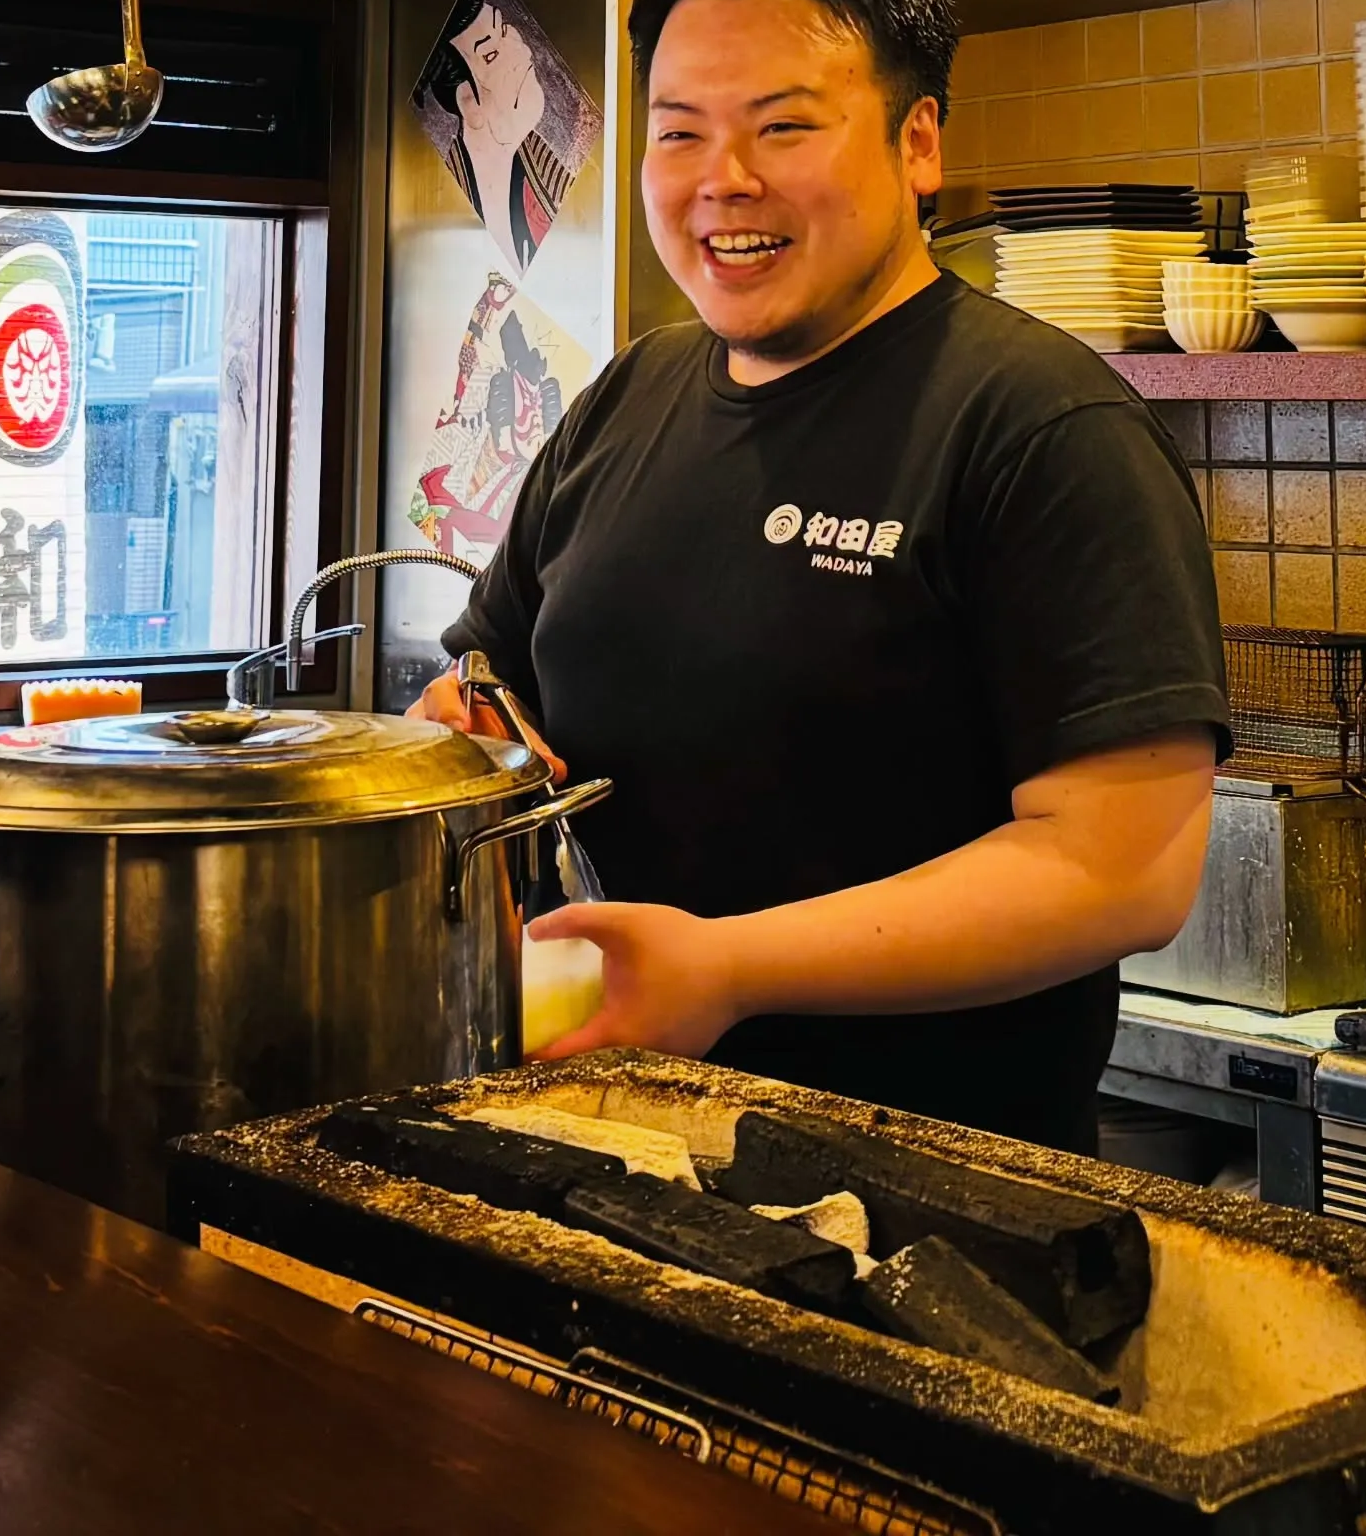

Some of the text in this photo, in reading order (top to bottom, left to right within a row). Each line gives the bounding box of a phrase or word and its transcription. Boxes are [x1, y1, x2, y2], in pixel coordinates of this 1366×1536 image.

[803, 511, 904, 559] 和田屋
[810, 553, 873, 576] WADAYA
